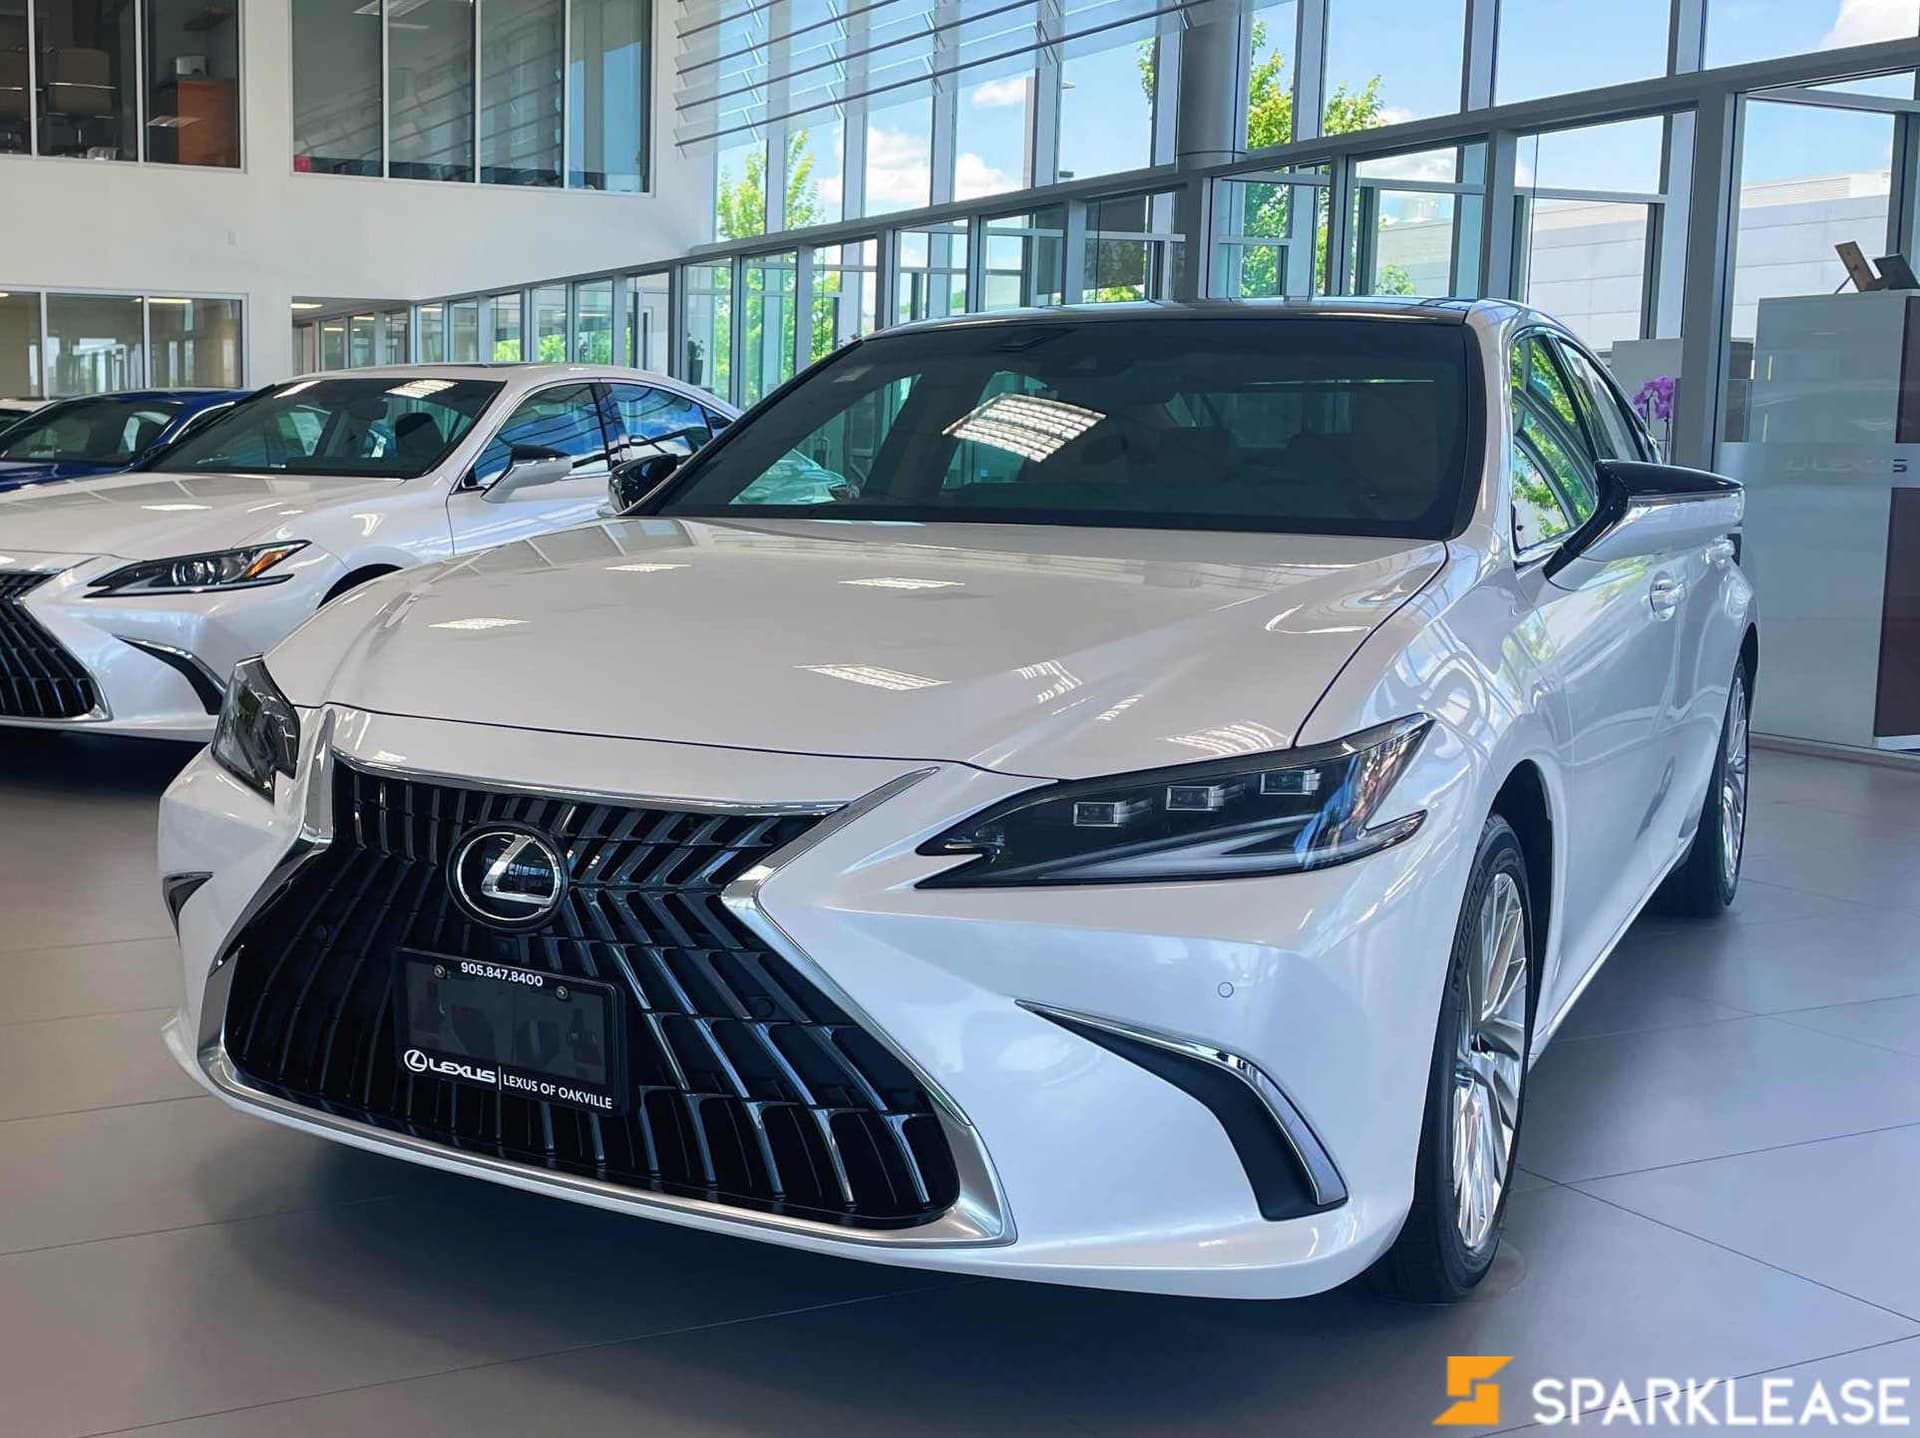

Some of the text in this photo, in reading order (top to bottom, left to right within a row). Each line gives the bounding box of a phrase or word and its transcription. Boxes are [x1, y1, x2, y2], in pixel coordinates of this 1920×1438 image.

[461, 961, 543, 987] 905.847.8400
[429, 1057, 497, 1084] LEXUS
[503, 1074, 613, 1110] LEXUS OF OAKVILLE
